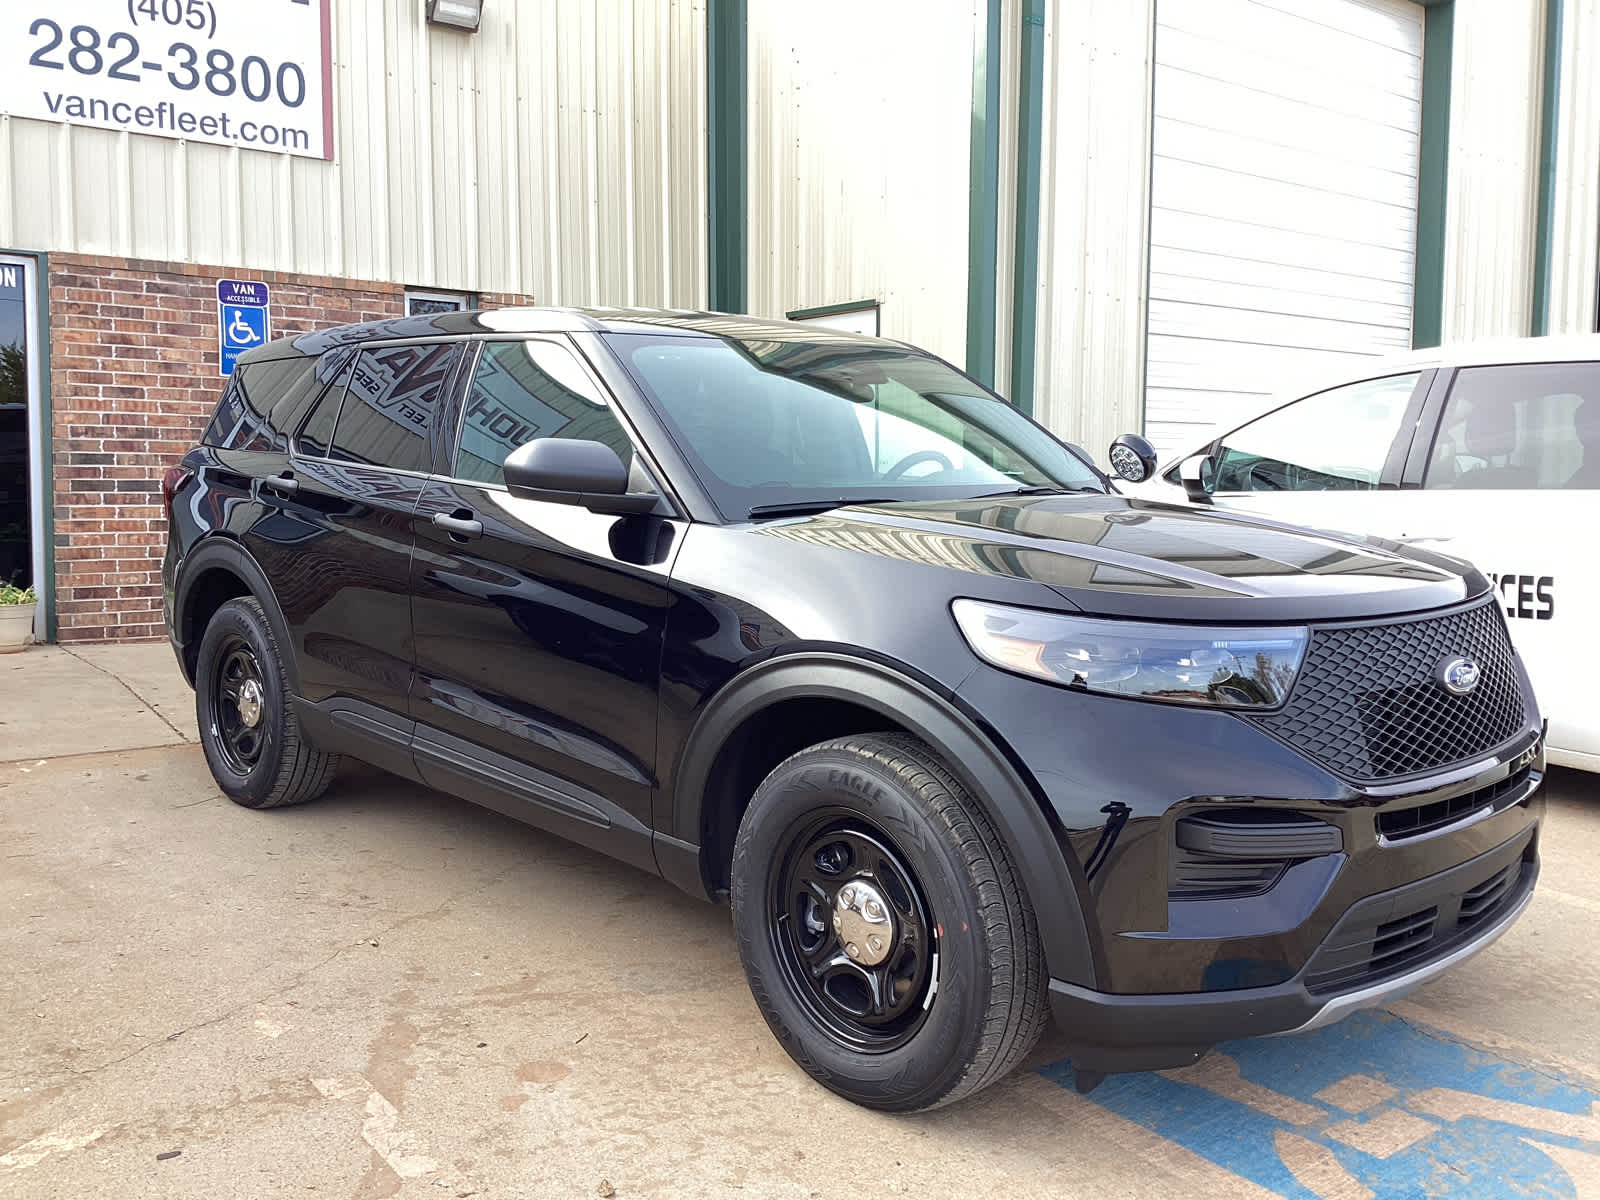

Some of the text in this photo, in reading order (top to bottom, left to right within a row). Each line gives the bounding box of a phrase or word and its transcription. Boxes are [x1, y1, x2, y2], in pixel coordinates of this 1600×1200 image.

[128, 0, 217, 39] (405)
[29, 18, 307, 108] 282-3800
[43, 91, 310, 149] vancefleet.com
[227, 295, 260, 304] ACCESSIBLE
[232, 283, 255, 295] VAN
[1487, 573, 1554, 620] CES
[829, 769, 887, 801] EAGLE
